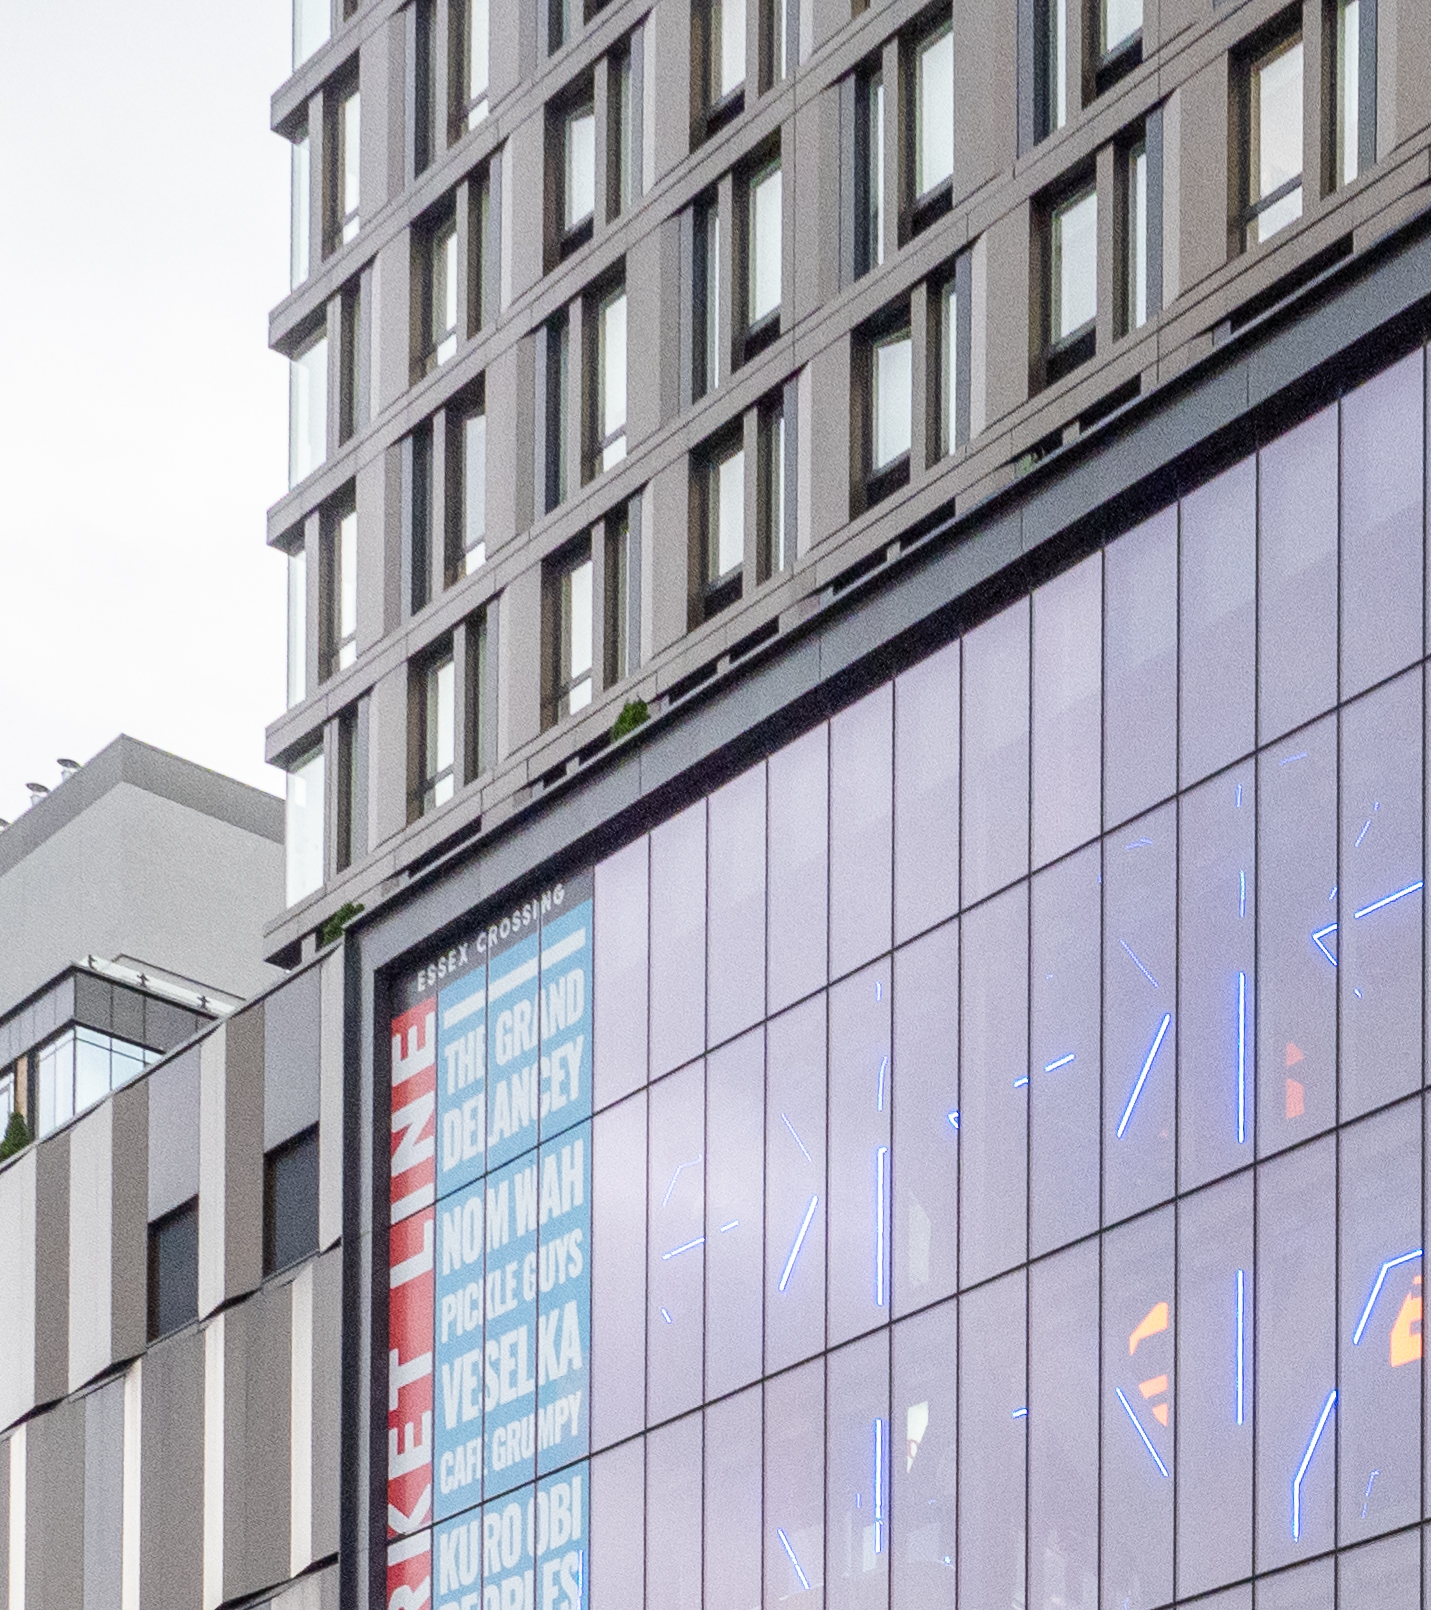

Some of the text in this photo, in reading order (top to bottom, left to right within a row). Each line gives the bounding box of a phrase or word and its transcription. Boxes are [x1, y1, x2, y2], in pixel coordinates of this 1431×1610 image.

[417, 883, 565, 992] ESSEX CROSSING
[445, 968, 585, 1095] THE GRAND
[388, 1010, 436, 1290] LINE
[443, 1035, 584, 1173] DELANCEY
[442, 1139, 584, 1276] NOM WAH
[441, 1228, 583, 1344] PICKLE GUYS
[442, 1300, 582, 1430] VESELKA
[491, 1391, 582, 1471] GRUMPY
[439, 1475, 582, 1596] KURO OBI
